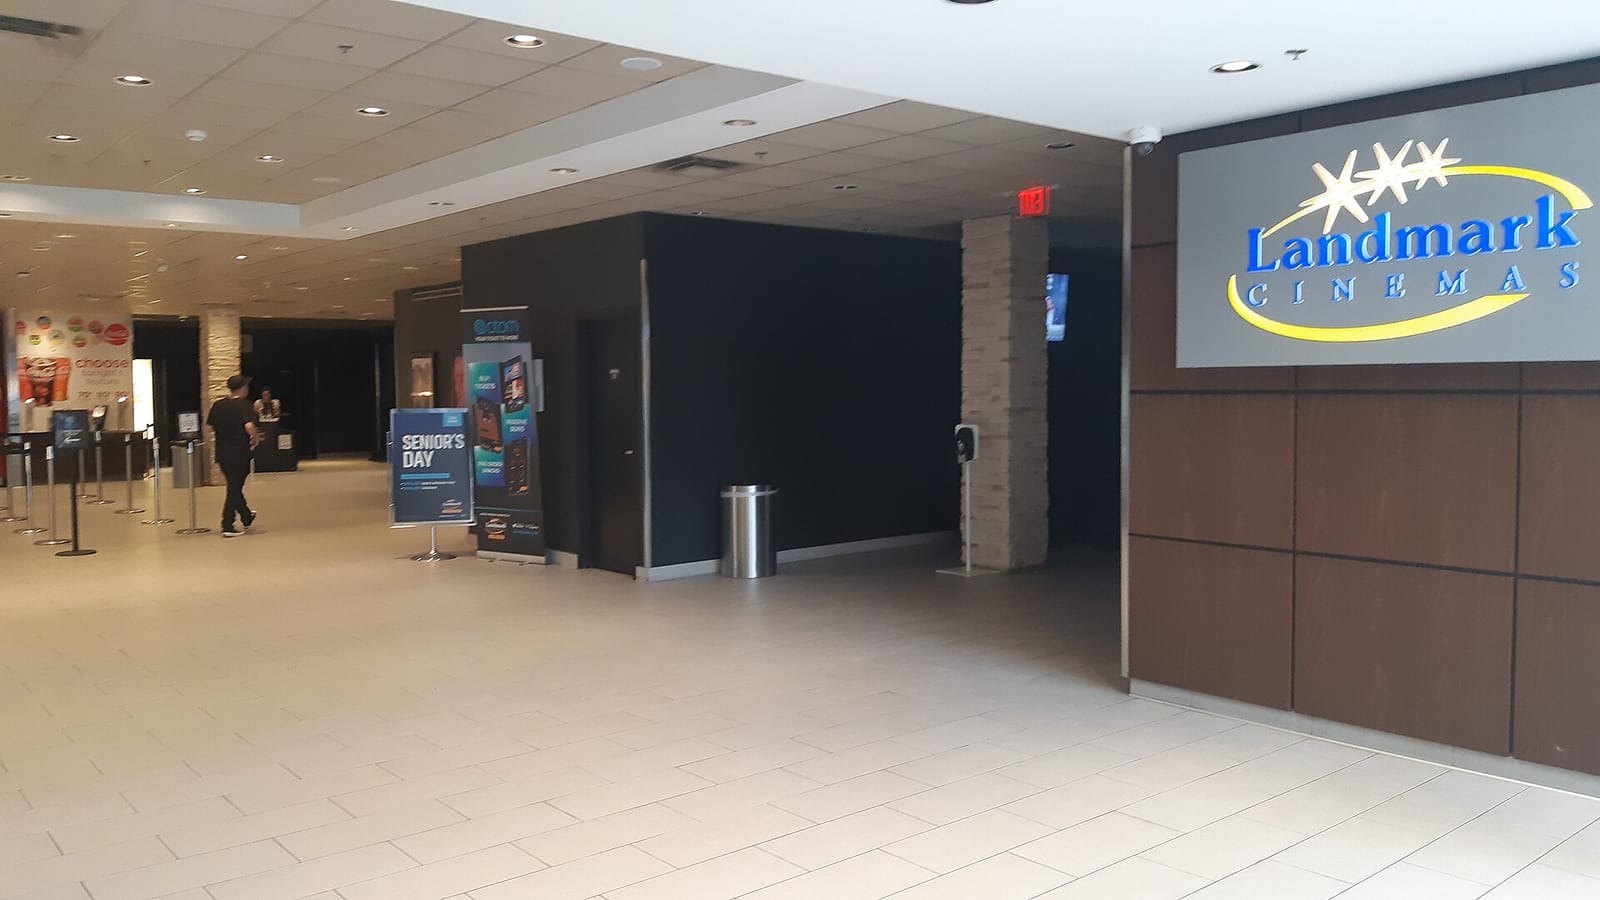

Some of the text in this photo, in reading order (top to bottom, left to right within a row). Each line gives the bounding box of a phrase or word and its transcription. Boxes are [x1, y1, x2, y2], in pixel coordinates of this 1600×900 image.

[1246, 194, 1581, 274] Landmark
[1246, 260, 1580, 307] CINEMAS
[76, 357, 129, 368] choose
[402, 433, 466, 451] SENIOR'S
[403, 450, 435, 469] DAY
